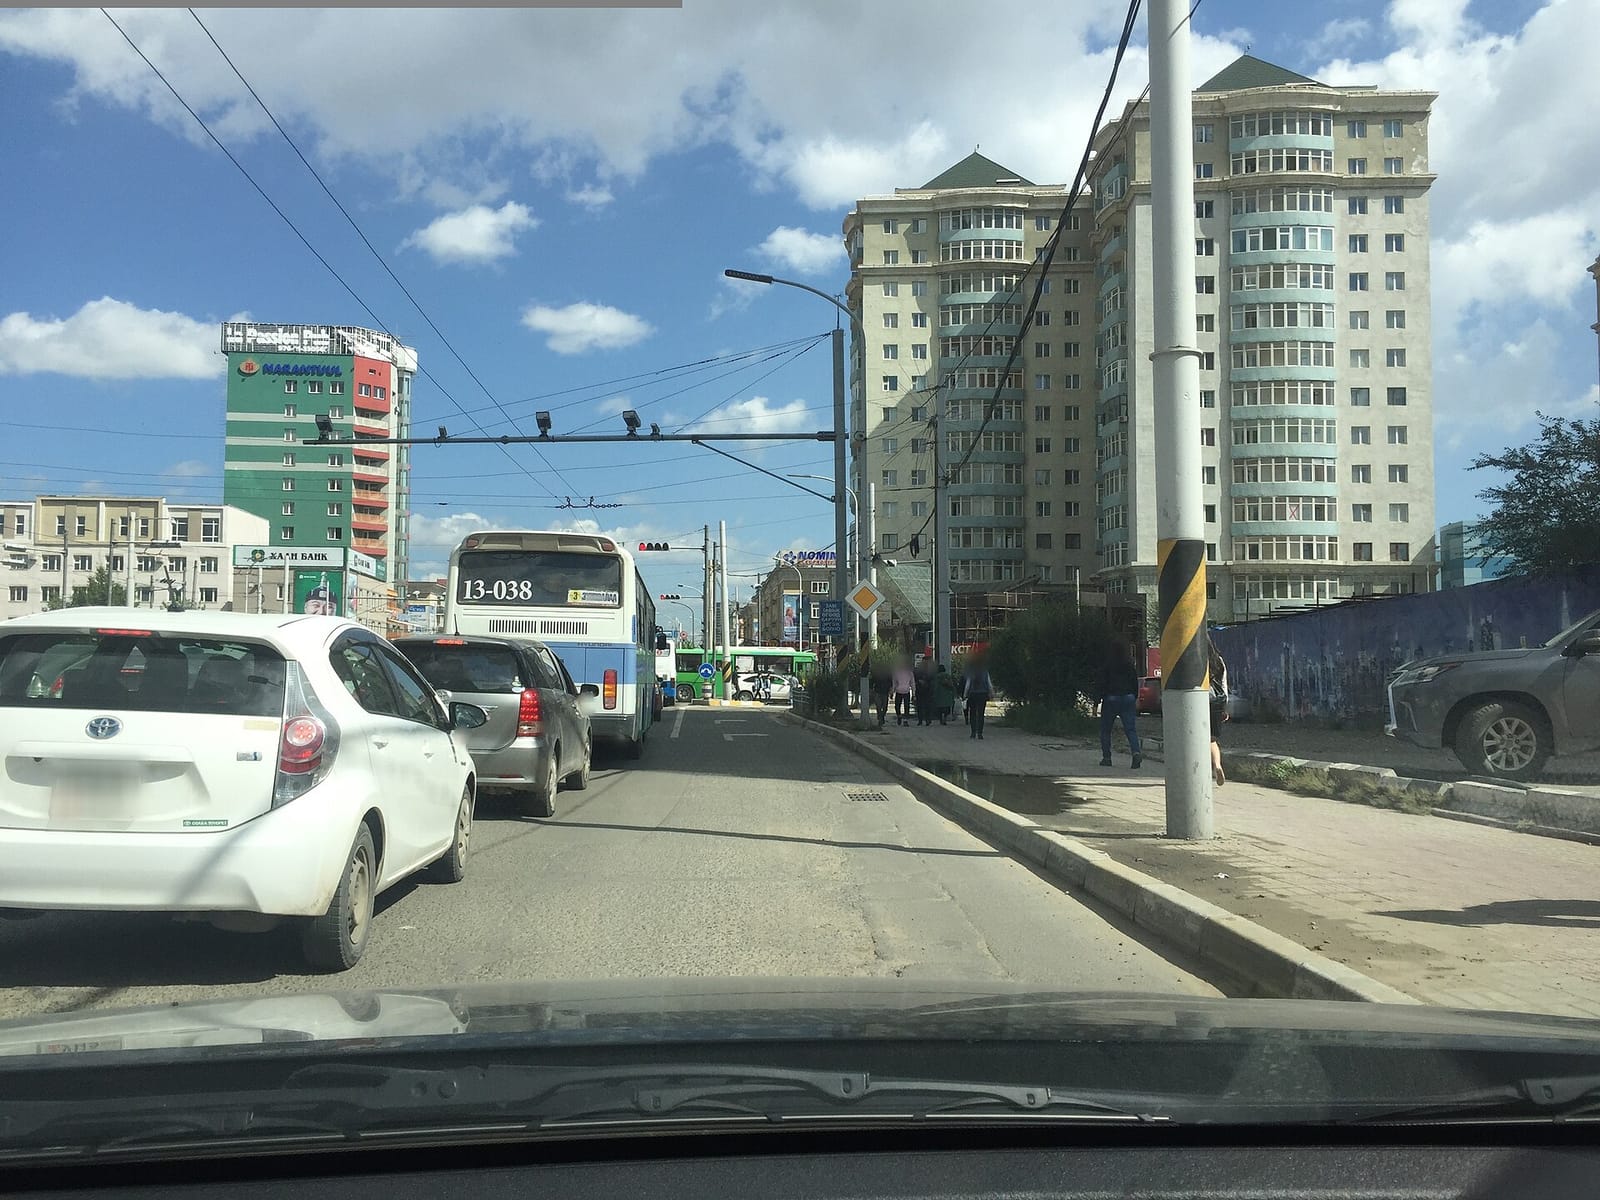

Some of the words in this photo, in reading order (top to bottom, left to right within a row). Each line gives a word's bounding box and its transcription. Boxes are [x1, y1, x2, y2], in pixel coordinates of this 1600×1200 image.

[263, 362, 342, 377] NARANTUUL
[301, 552, 328, 562] БАНК
[798, 551, 836, 560] NOMIN
[463, 579, 533, 601] 13-038
[573, 591, 578, 600] 3
